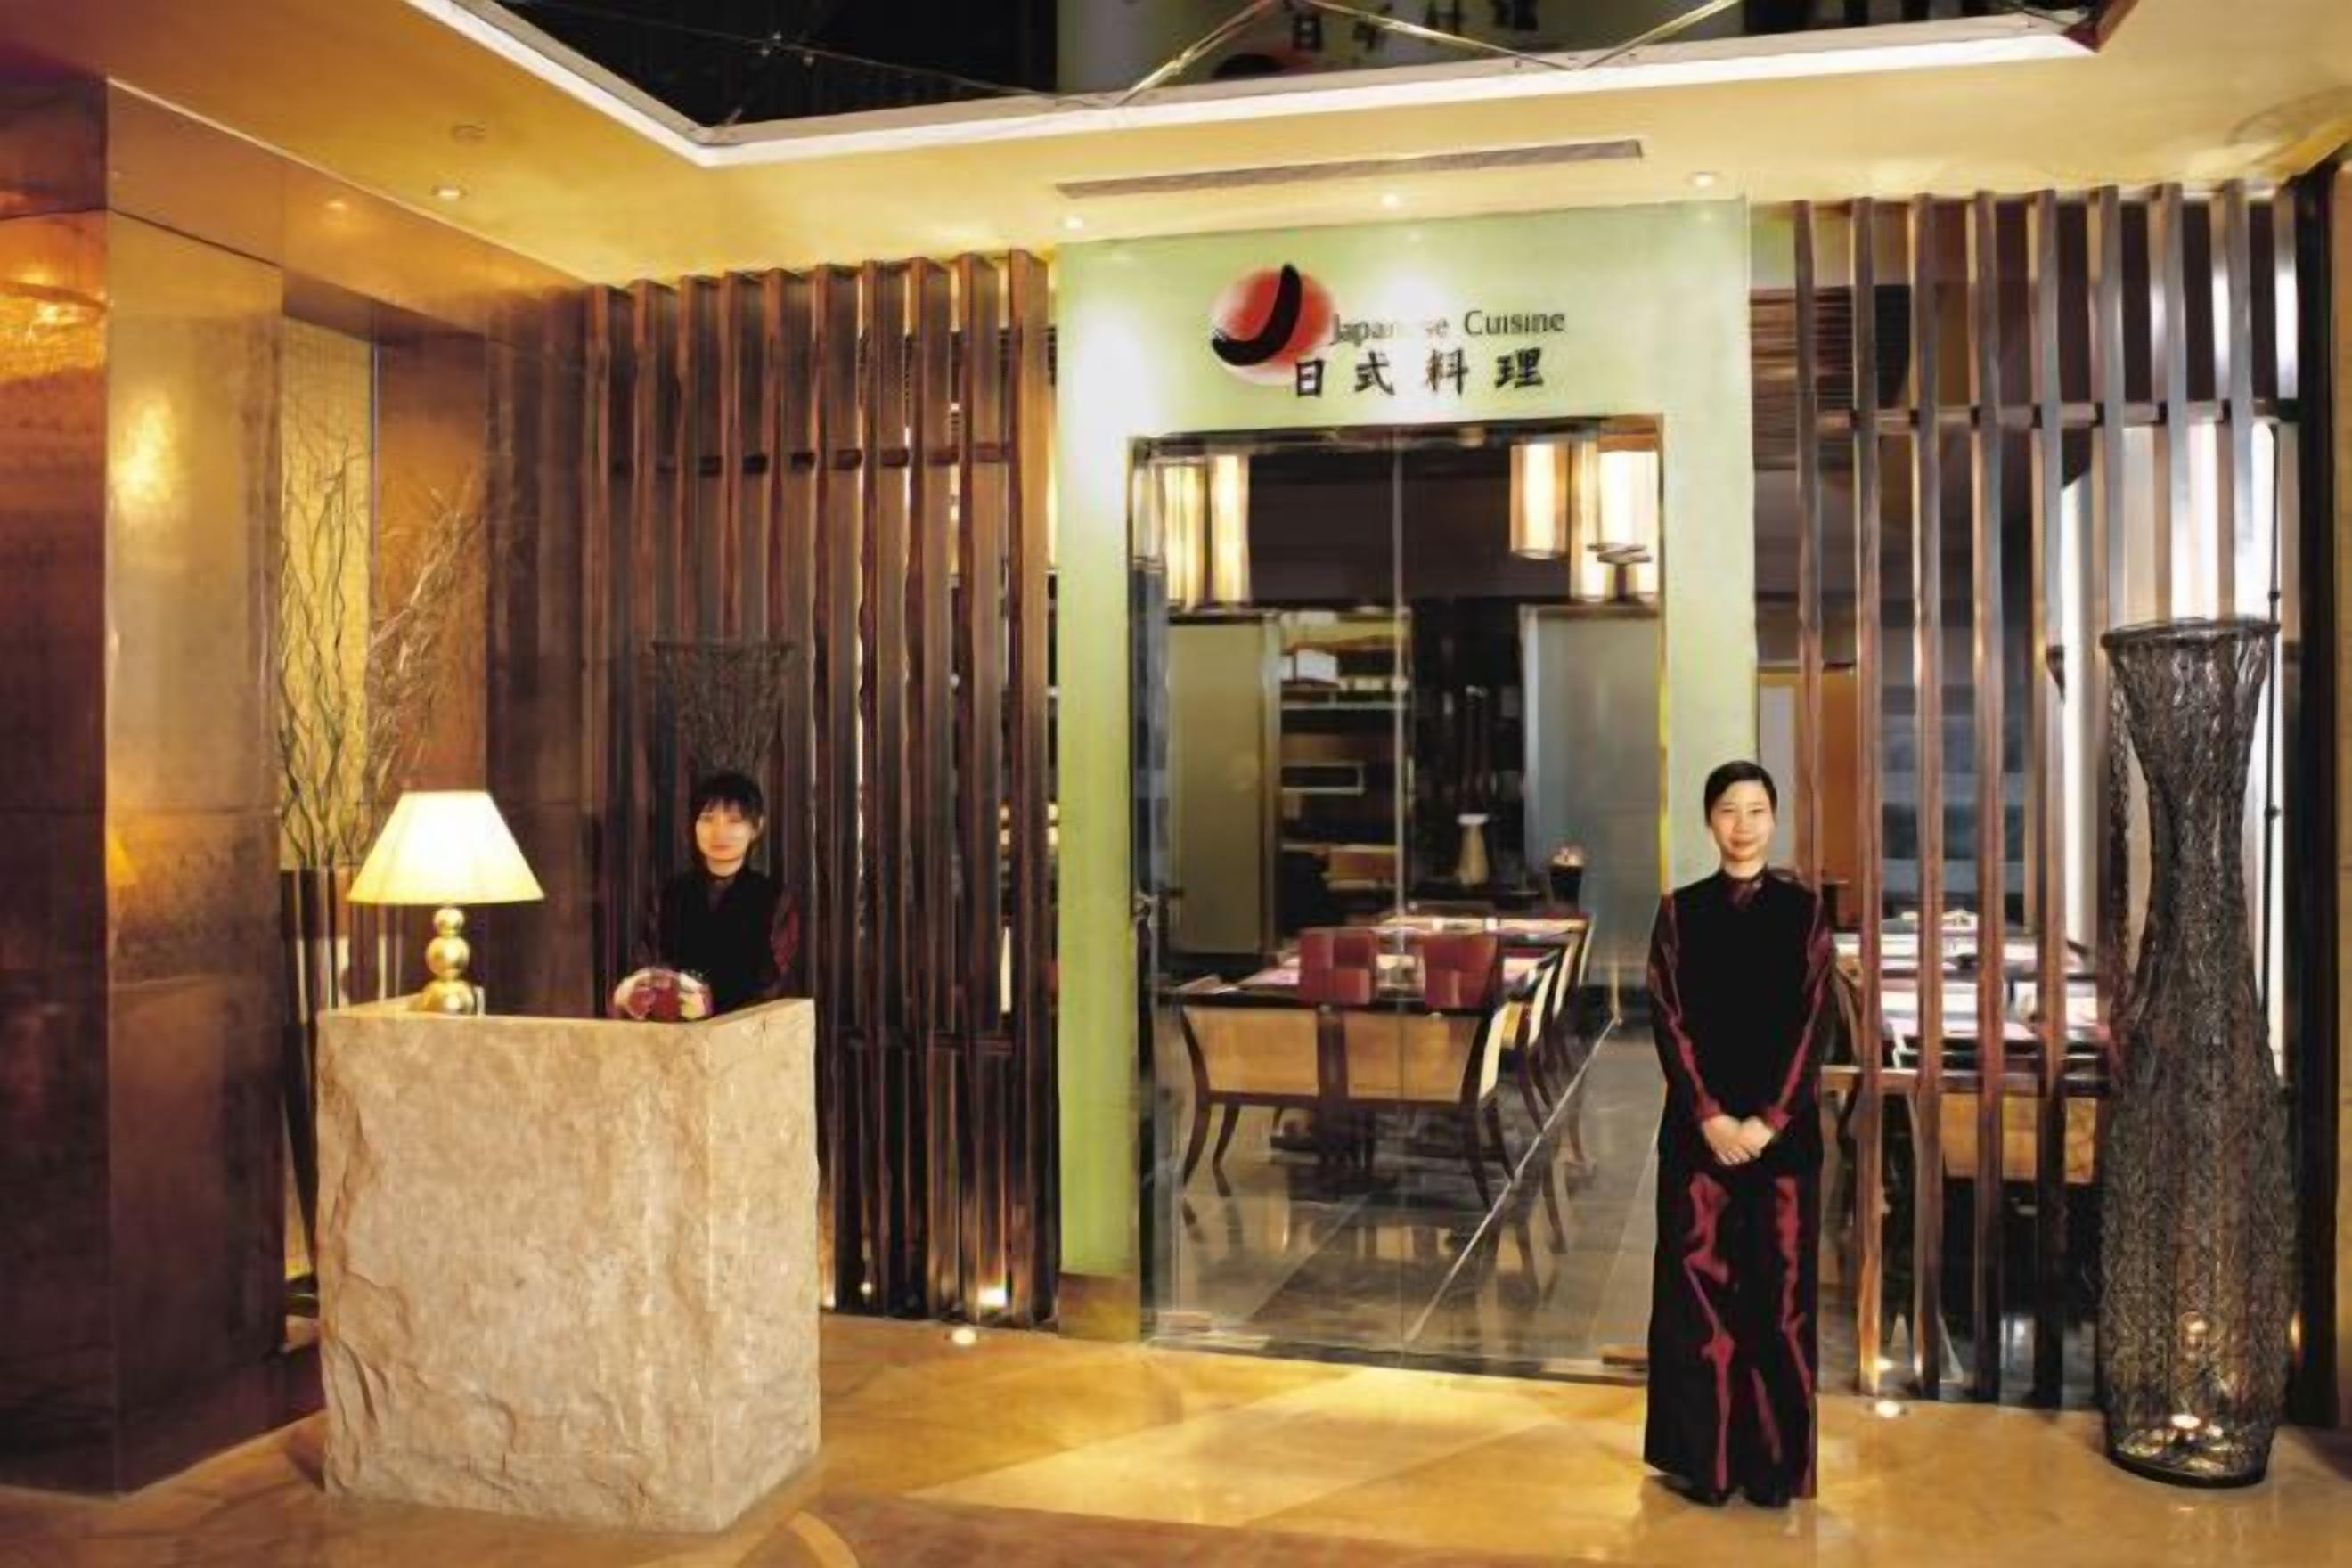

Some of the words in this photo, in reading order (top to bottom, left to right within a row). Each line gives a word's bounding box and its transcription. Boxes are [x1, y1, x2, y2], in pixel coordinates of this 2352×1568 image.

[1330, 313, 1450, 347] Japae
[1463, 309, 1565, 336] Cuisine
[1296, 348, 1544, 398] 日式料理
